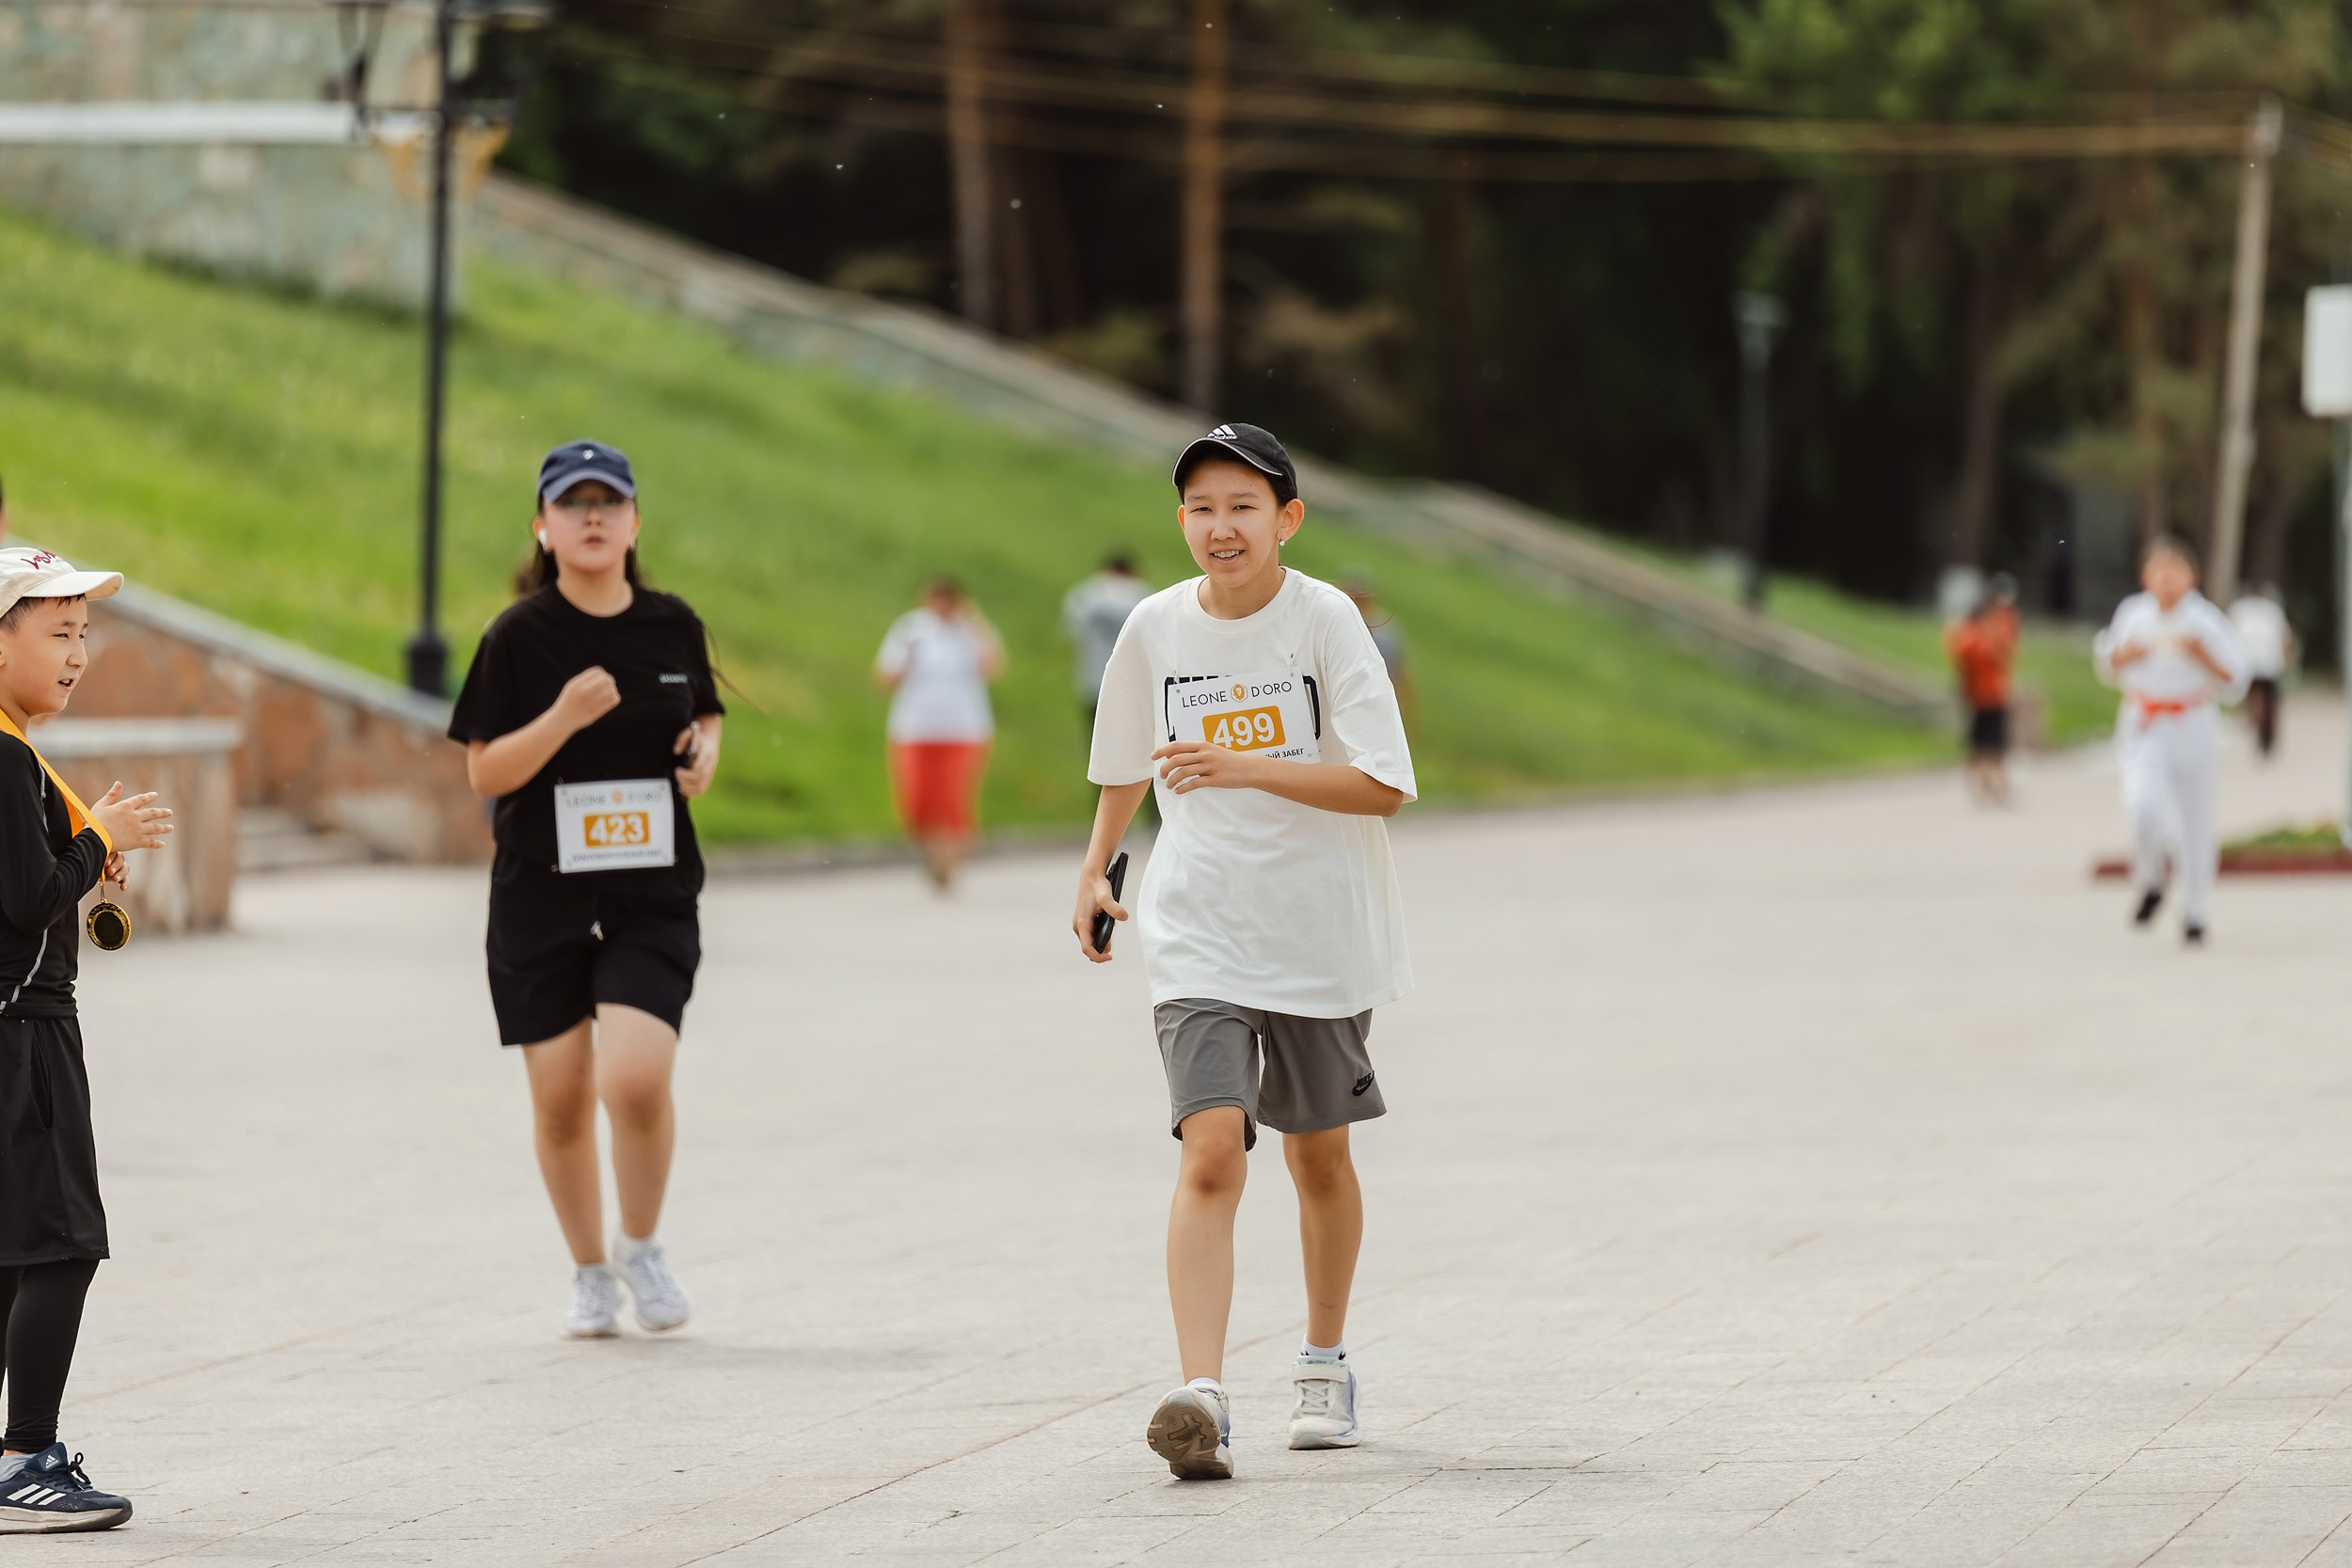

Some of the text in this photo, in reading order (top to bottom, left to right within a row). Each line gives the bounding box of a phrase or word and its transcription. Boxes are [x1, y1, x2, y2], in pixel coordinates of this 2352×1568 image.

[1182, 681, 1293, 708] LEONE D'ORO
[1212, 712, 1276, 749] 499
[1282, 748, 1305, 758] ЗАБЕГ
[588, 813, 645, 844] 423
